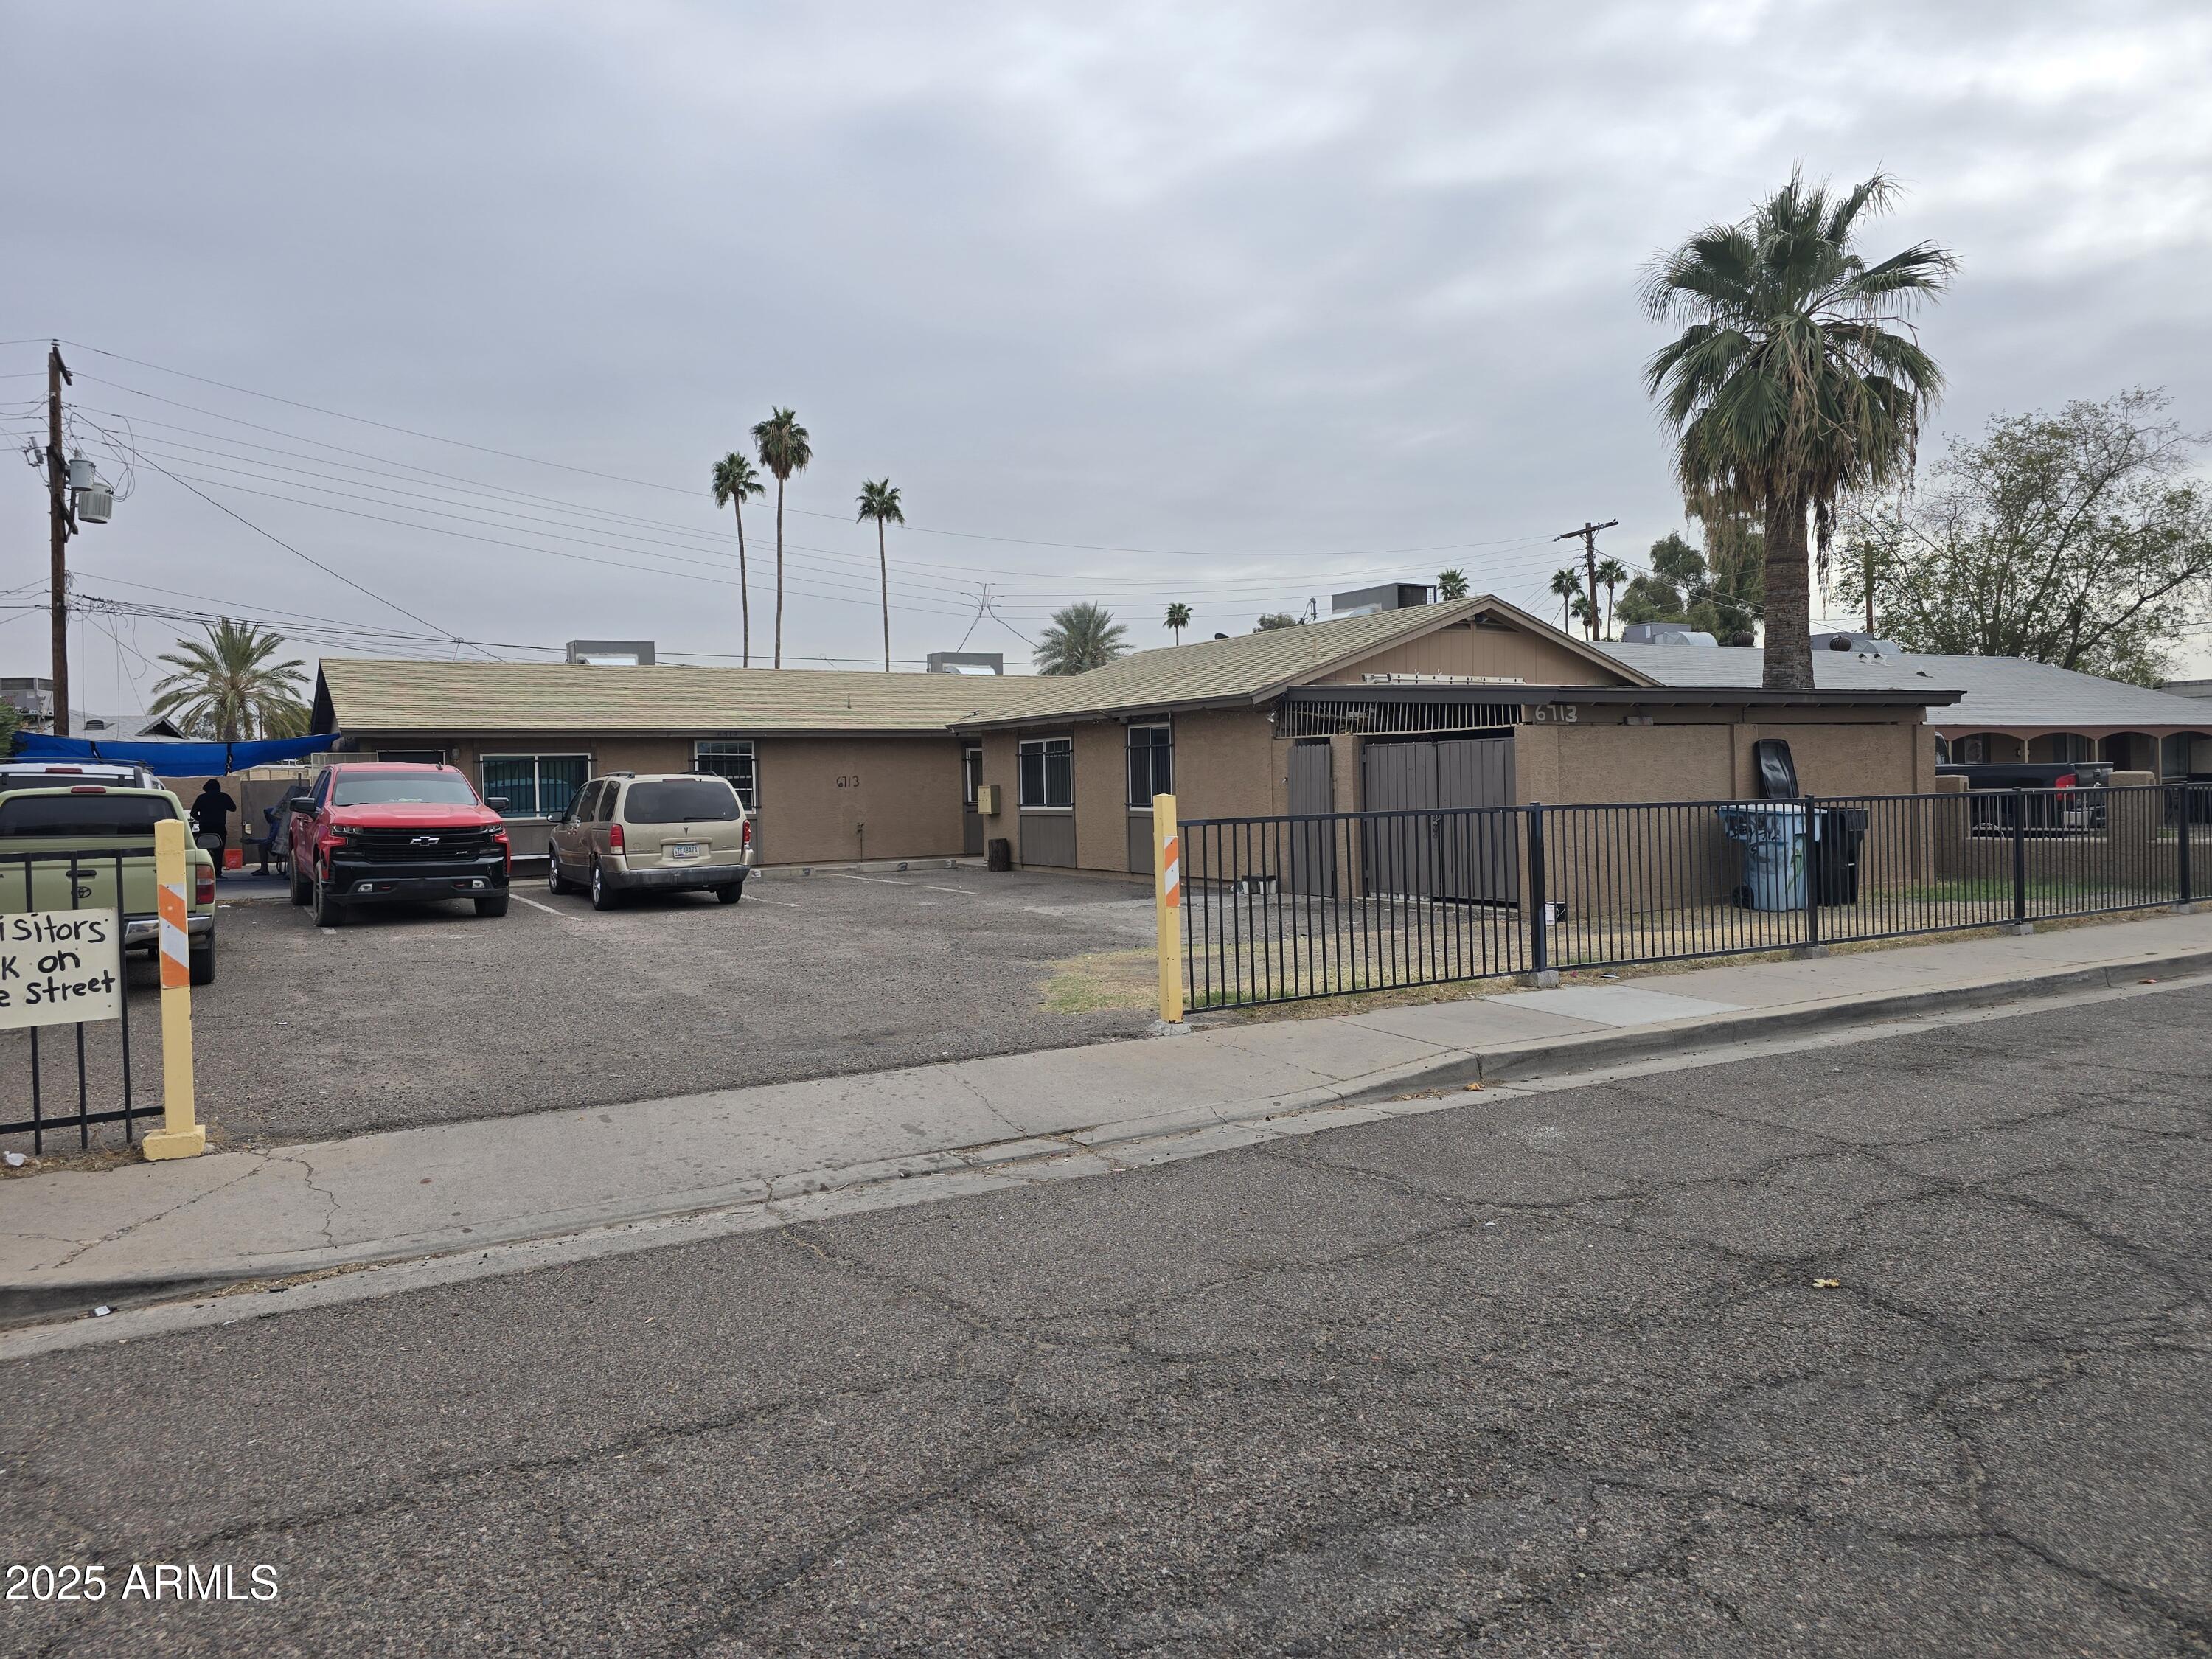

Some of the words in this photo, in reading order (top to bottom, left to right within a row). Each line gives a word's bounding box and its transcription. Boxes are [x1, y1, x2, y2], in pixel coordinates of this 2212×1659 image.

[1535, 704, 1578, 723] 6713
[836, 775, 860, 788] 6713
[37, 950, 81, 974] on
